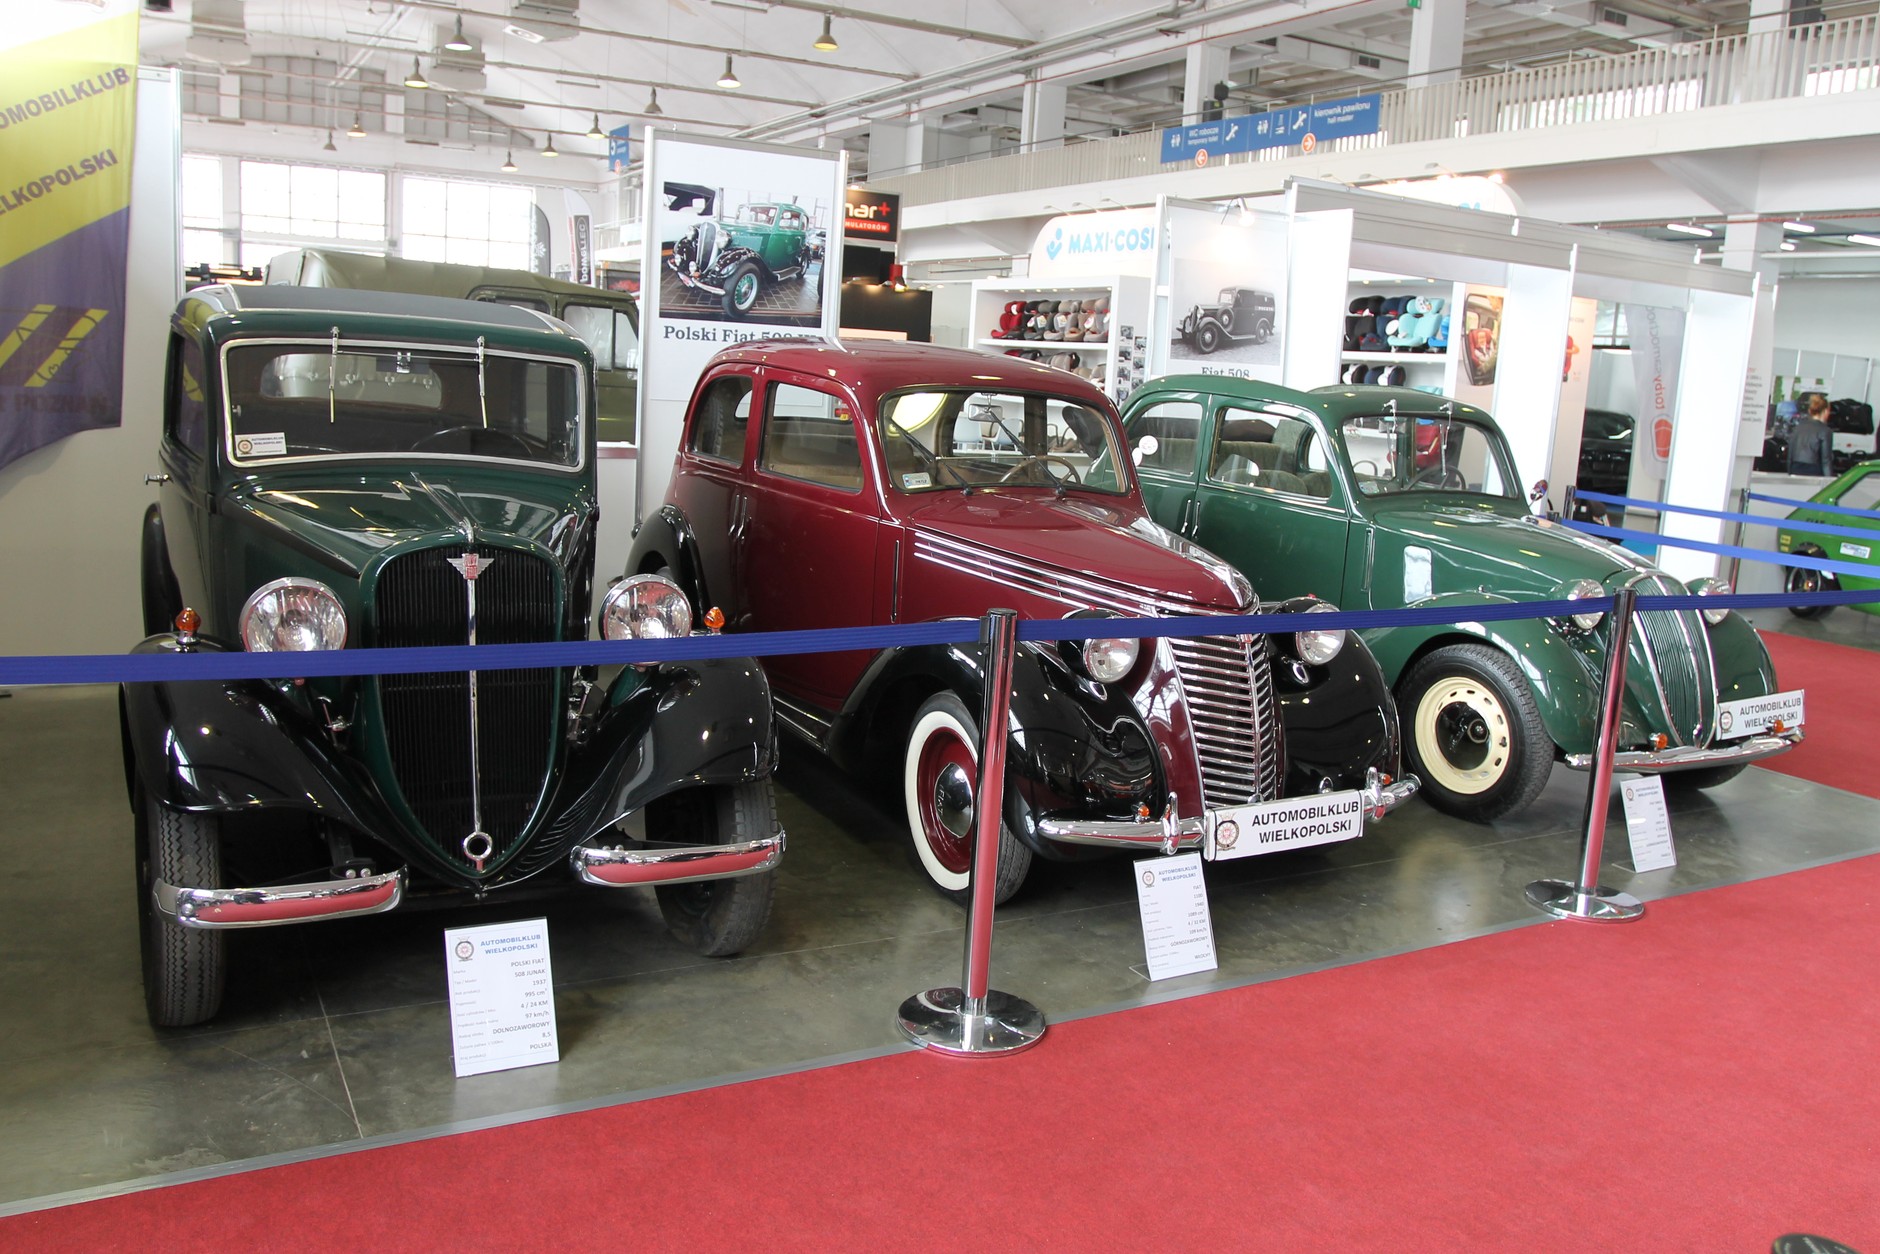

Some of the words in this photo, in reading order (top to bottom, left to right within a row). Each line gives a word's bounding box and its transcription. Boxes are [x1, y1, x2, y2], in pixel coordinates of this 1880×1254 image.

[664, 326, 717, 342] Polski
[722, 329, 756, 342] Fiat
[1201, 366, 1224, 376] Fiat
[1228, 368, 1250, 378] 508
[1740, 698, 1801, 716] AUTOMOBILKLUB
[1252, 801, 1359, 827] AUTOMOBILKLUB
[1259, 820, 1352, 843] WIELKOPOLSKI
[1158, 865, 1197, 875] AUTOMOBILKLUB
[1162, 873, 1196, 882] WIELKOPOLSKI
[480, 934, 541, 947] AUTOMOBILKLUB
[485, 943, 538, 954] WIELKOPOLSKI
[493, 1022, 550, 1034] DOLNOZAWOROWY
